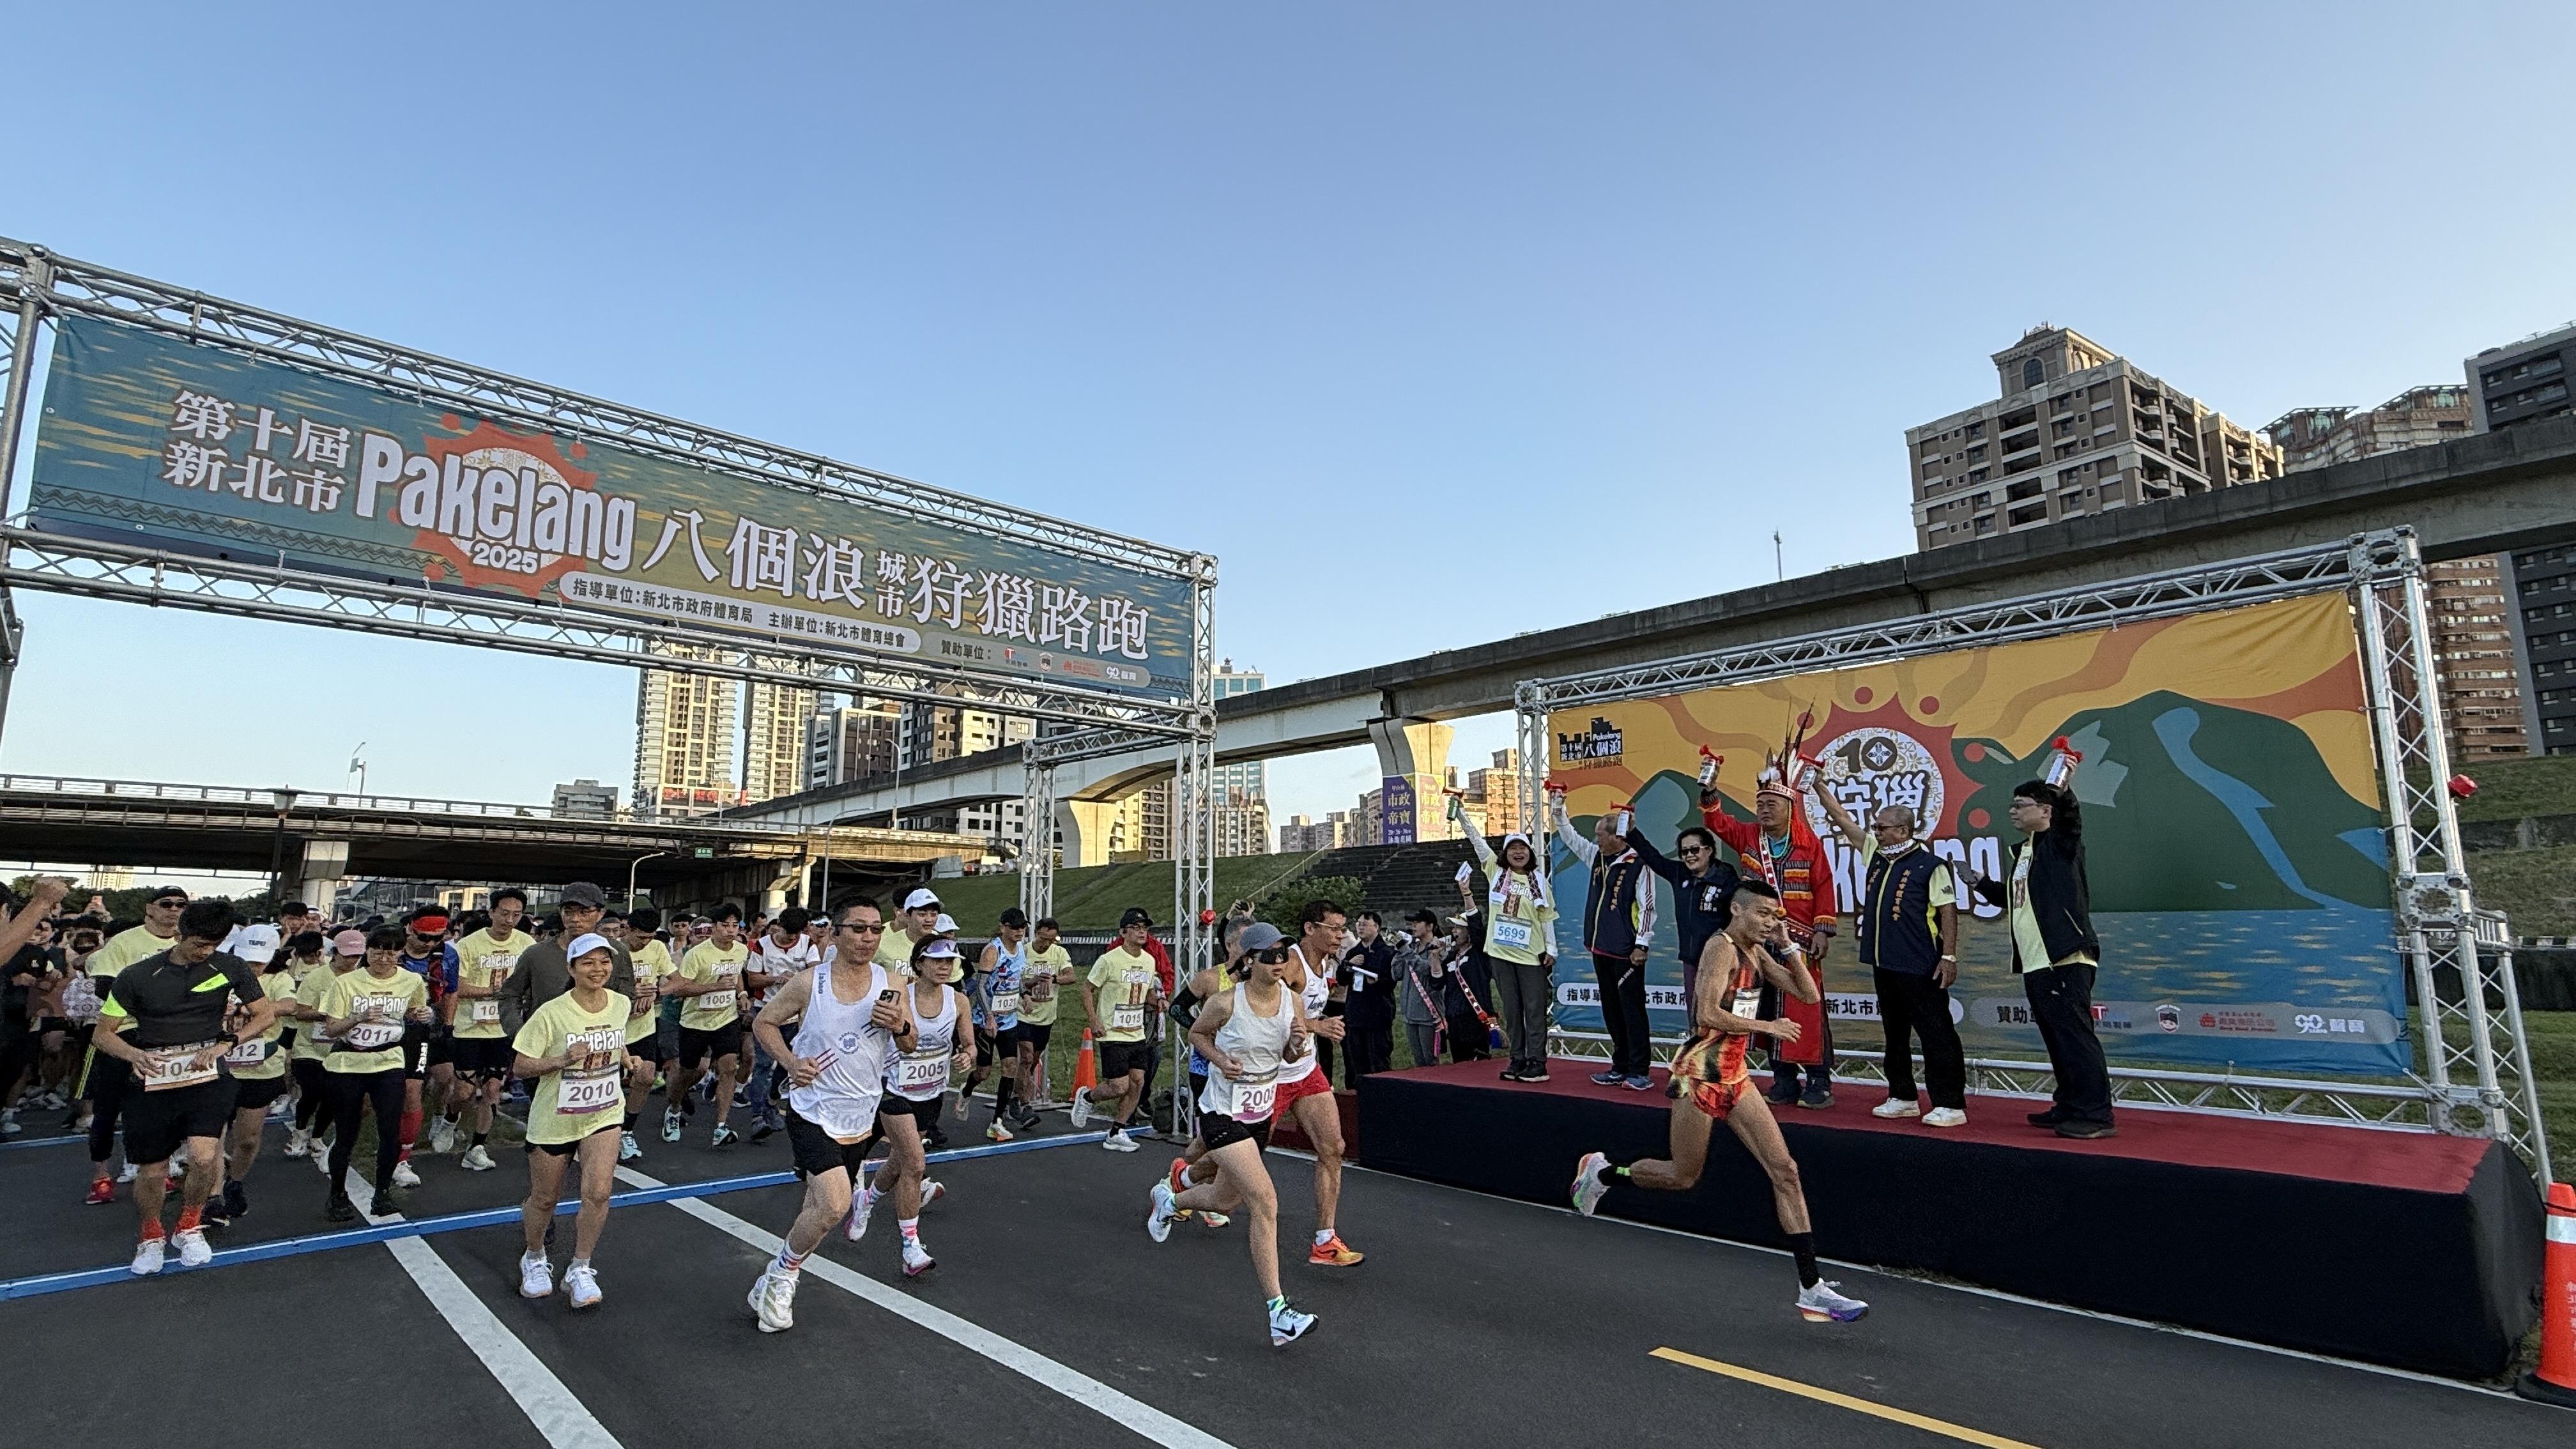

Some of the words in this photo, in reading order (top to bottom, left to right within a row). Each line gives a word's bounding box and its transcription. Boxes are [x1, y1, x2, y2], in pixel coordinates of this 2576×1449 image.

[171, 389, 350, 469] 第十屆
[164, 439, 346, 513] 新北市
[356, 433, 637, 571] Pakelang
[471, 540, 539, 574] 2025
[641, 508, 865, 607] 八個浪
[908, 553, 1150, 662] 狩獵路跑
[1583, 739, 1622, 758] 八個浪
[1834, 736, 1898, 773] 10
[1388, 792, 1411, 808] 市政
[1498, 926, 1526, 940] 5699
[705, 993, 732, 1005] 1005
[480, 1005, 496, 1016] 10
[350, 1027, 392, 1043] 2011
[906, 1061, 944, 1081] 2005
[567, 1080, 615, 1102] 2010
